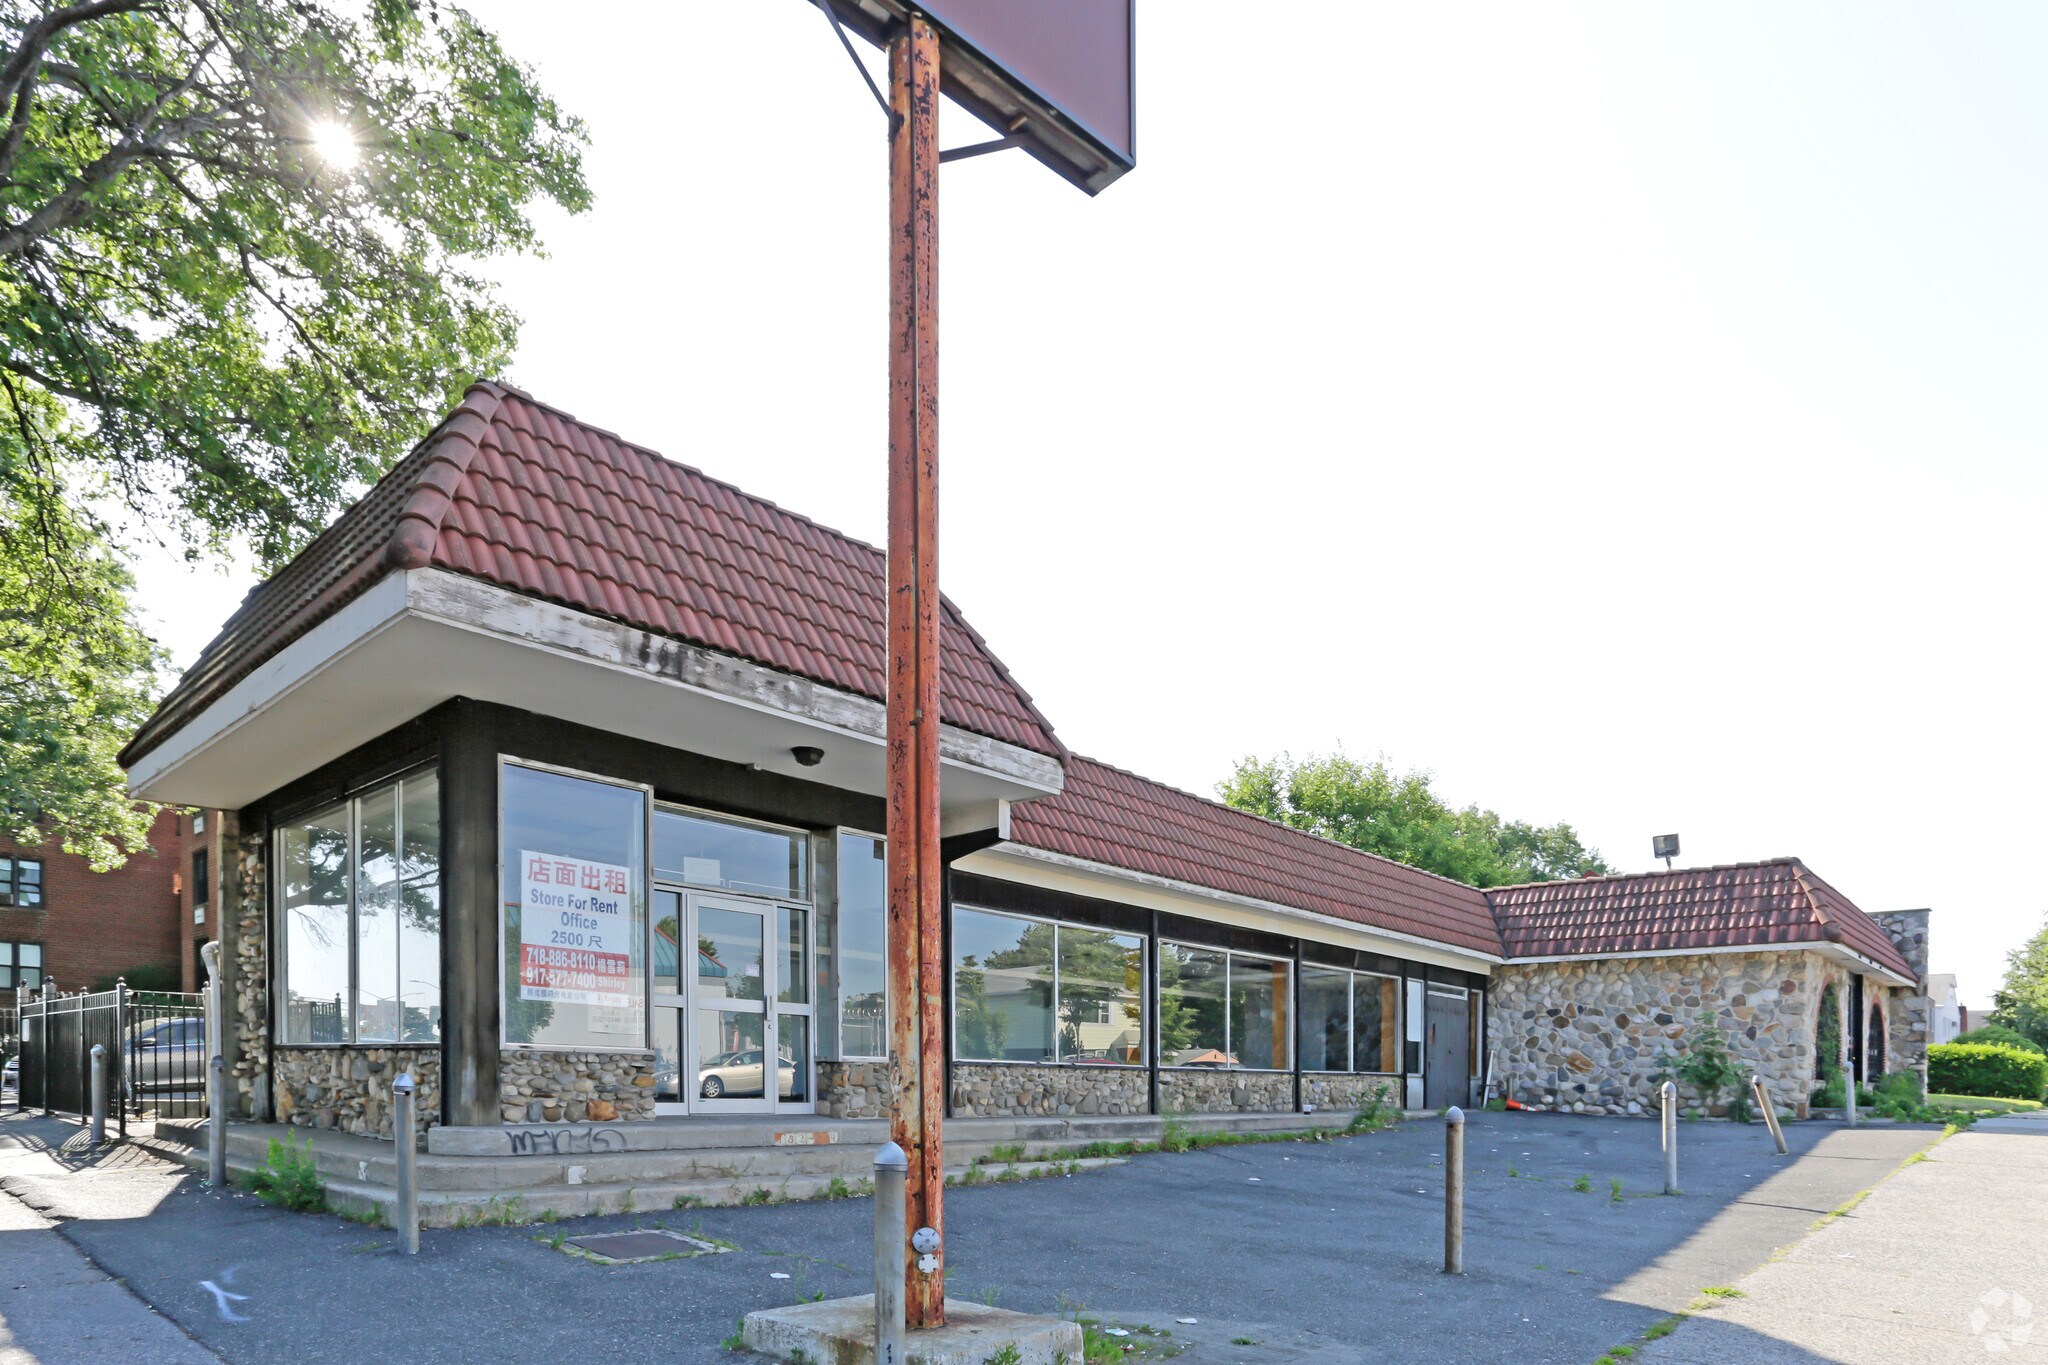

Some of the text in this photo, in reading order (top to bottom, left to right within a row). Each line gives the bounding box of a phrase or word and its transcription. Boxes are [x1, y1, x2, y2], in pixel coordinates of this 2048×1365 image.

[527, 857, 627, 894] 店面出租
[531, 888, 618, 915] Store For Rent
[561, 911, 598, 930] Office
[551, 930, 603, 949] 2500 尺
[526, 947, 596, 970] 718-886-8110
[526, 966, 626, 991] 917-577-7400 Shirley
